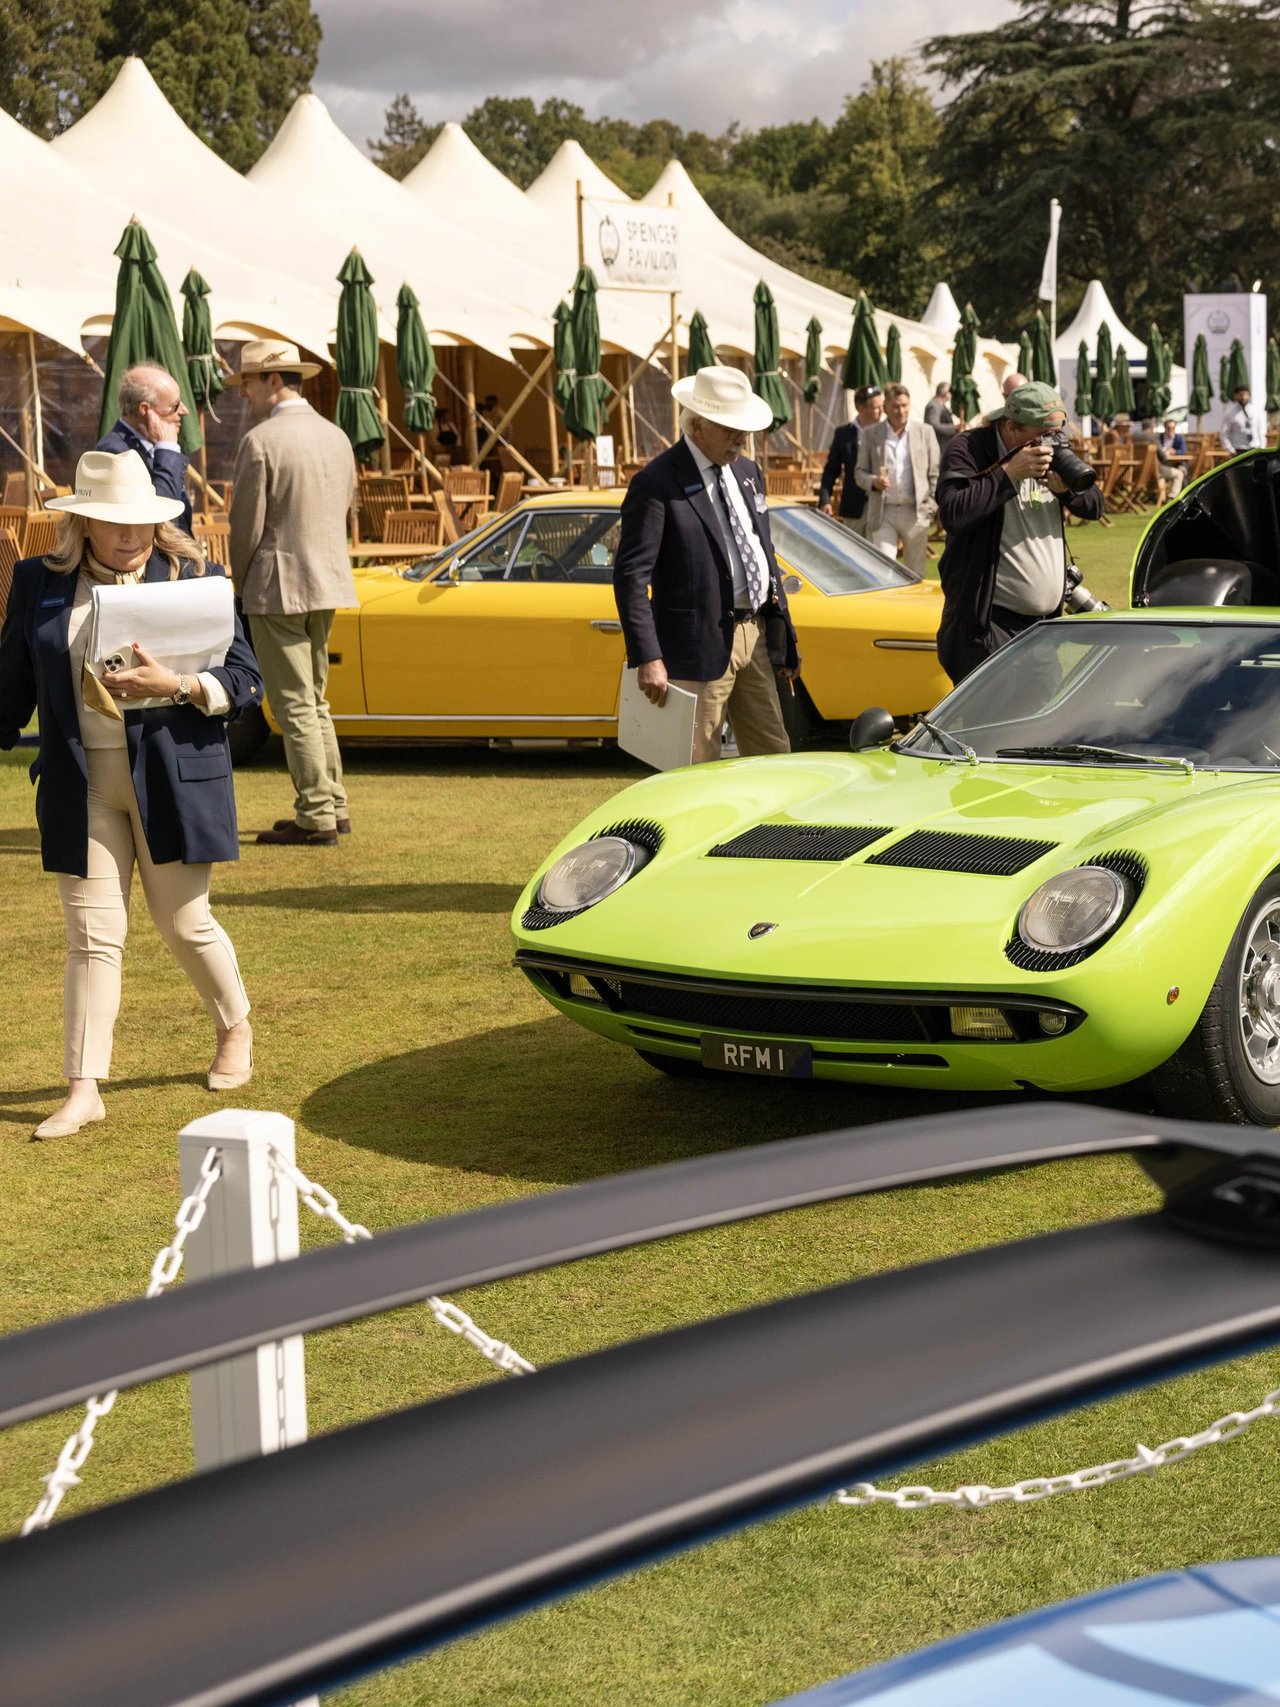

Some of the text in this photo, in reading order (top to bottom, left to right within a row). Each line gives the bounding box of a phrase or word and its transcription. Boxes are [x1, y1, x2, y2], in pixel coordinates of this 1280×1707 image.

[626, 220, 678, 244] SPENCER
[627, 247, 678, 272] PAVILION
[723, 1042, 771, 1070] RFM
